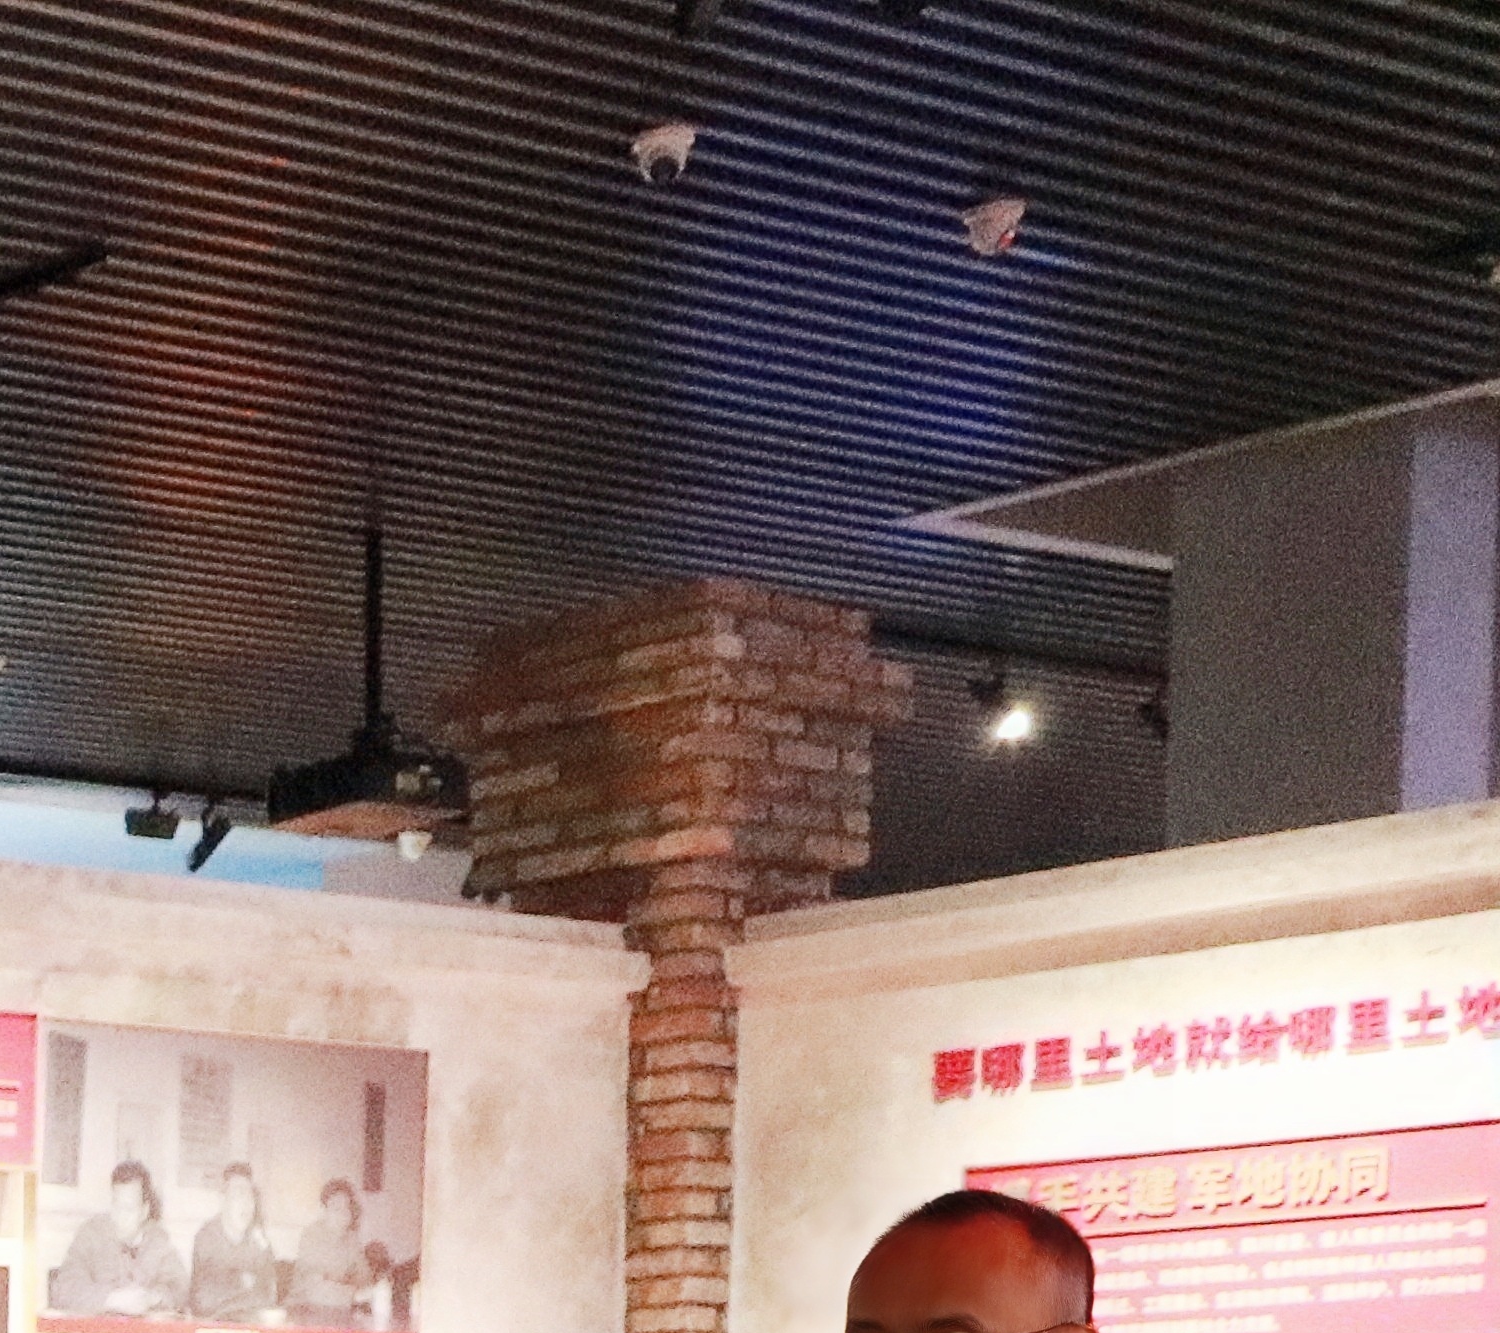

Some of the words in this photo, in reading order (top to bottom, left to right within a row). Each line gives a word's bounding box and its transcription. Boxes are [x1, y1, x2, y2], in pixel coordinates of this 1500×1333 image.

[932, 981, 1500, 1105] 要哪里土地就给哪里土地
[1186, 1145, 1391, 1214] 军地协同
